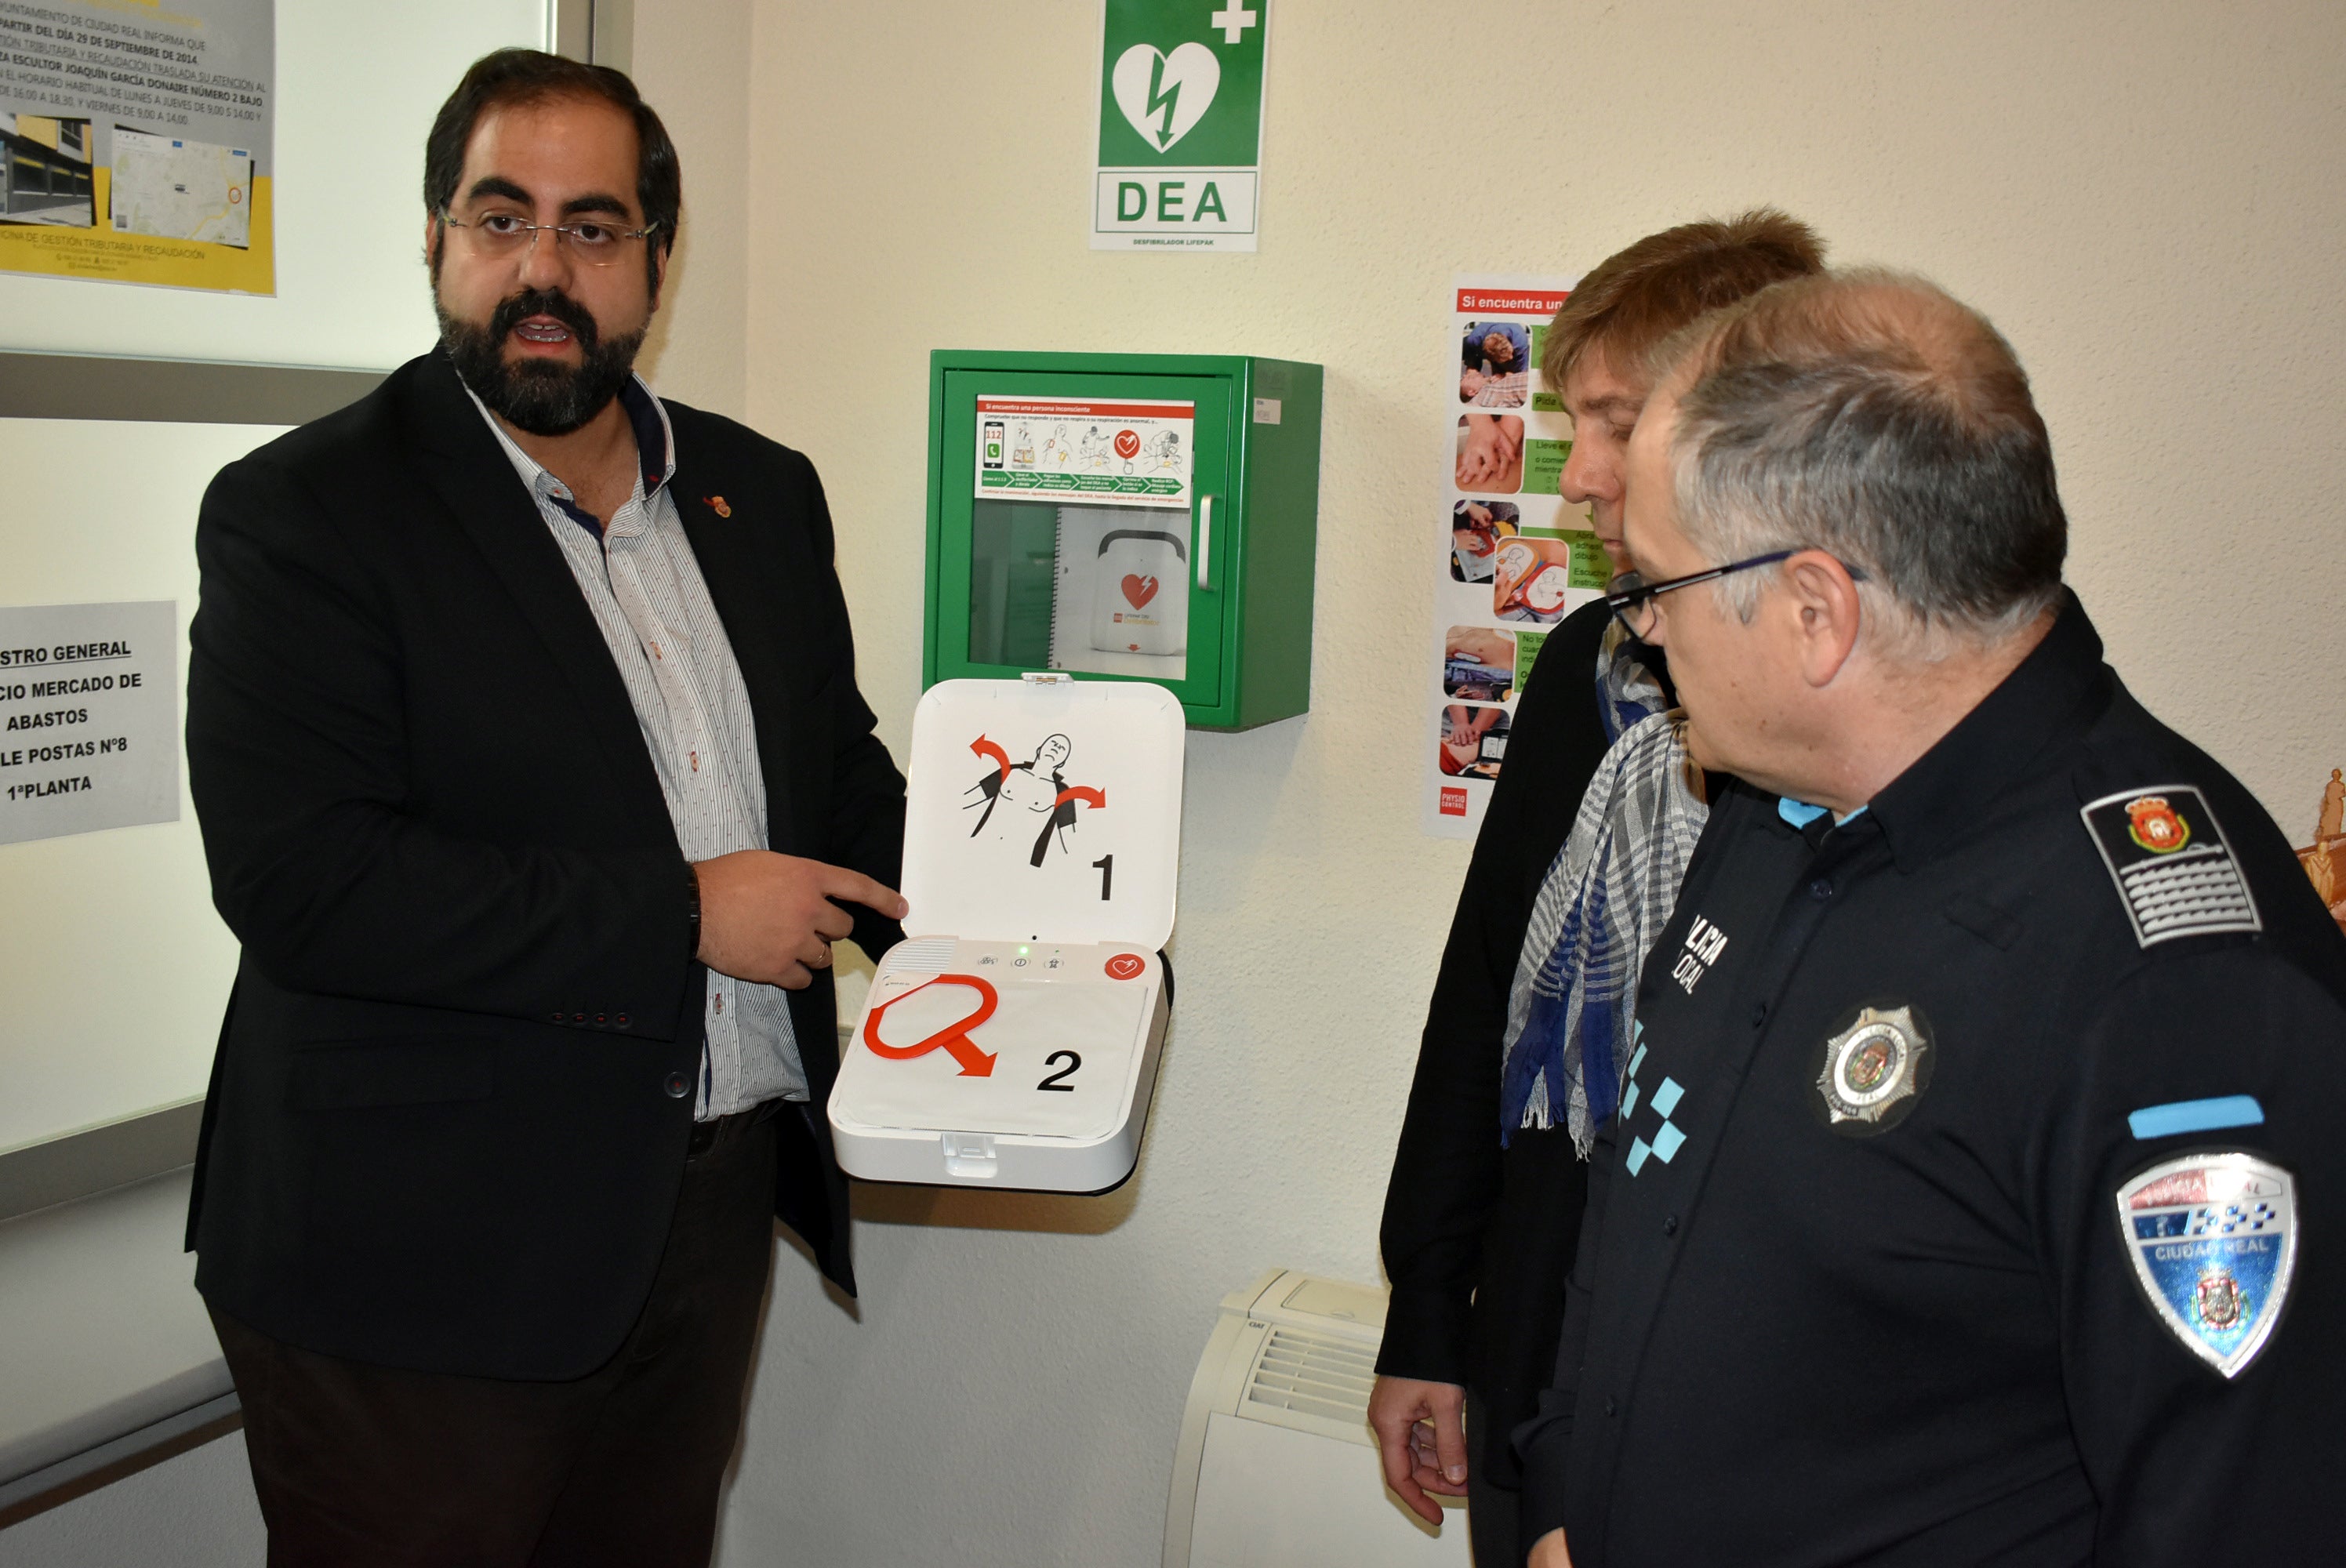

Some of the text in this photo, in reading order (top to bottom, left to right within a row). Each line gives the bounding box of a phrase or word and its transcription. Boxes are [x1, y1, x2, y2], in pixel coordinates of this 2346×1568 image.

[35, 26, 53, 37] DEL
[56, 27, 74, 40] DÍA
[77, 33, 88, 43] 29
[90, 35, 102, 46] DE
[104, 38, 159, 58] SEPTIEMBRE
[162, 49, 173, 60] DE
[71, 15, 82, 27] DE
[85, 18, 120, 34] CIUDAD
[122, 25, 142, 39] REAL
[144, 30, 185, 46] INFORMA
[187, 38, 205, 51] QUE
[13, 54, 63, 71] ESCULTOR
[65, 64, 107, 80] JOAQUÍN
[110, 71, 144, 86] GARCÍA
[147, 78, 189, 95] DONAIRE
[191, 85, 230, 101] NÚMERO
[232, 93, 238, 103] 2
[24, 39, 77, 56] TRIBUTARIA
[154, 64, 196, 80] TRASLADA
[199, 72, 210, 82] SU
[256, 83, 267, 93] AL
[6, 70, 16, 81] EL
[17, 72, 64, 89] HORARIO
[65, 80, 108, 96] HABITUAL
[111, 87, 122, 98] DE
[123, 89, 152, 103] LUNES
[154, 96, 162, 104] A
[163, 96, 192, 111] JUEVES
[194, 102, 205, 112] DE
[256, 113, 262, 122] Y
[40, 92, 47, 101] A
[78, 97, 84, 106] Y
[85, 99, 121, 114] VIERNES
[122, 105, 133, 115] DE
[157, 111, 164, 121] A
[1117, 181, 1228, 223] DEA
[42, 234, 82, 246] GESTIÓN
[1462, 296, 1476, 308] Si
[1478, 298, 1543, 310] encuentra
[986, 430, 1002, 439] 112
[53, 641, 132, 662] GENERAL
[1522, 634, 1534, 643] No
[32, 675, 114, 699] MERCADO
[119, 673, 142, 689] DE
[6, 708, 89, 731] ABASTOS
[28, 741, 96, 764] POSTAS
[7, 775, 93, 801] 1ªPLANTA
[1442, 793, 1465, 804] PHYSIO
[1441, 800, 1465, 809] CONTROL
[1092, 854, 1113, 901] 1
[1037, 1049, 1082, 1092] 2
[2155, 1238, 2269, 1261] CIUDAD REAL
